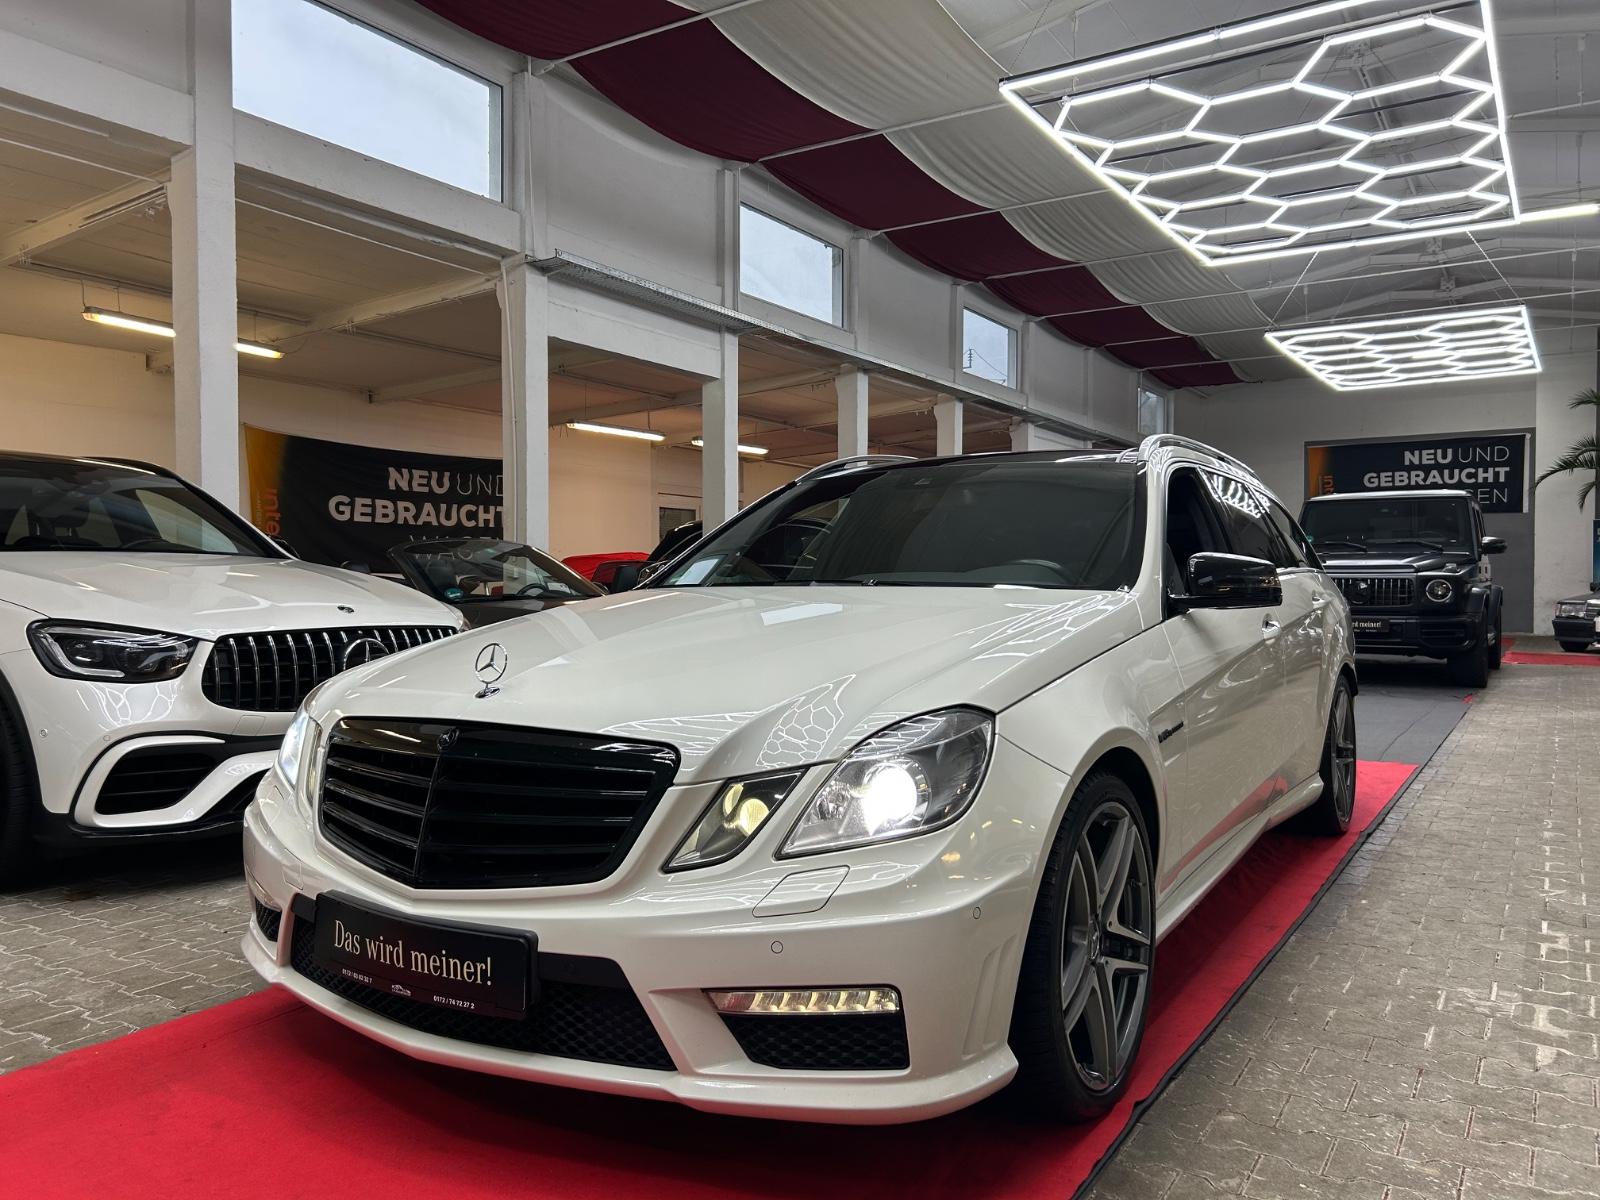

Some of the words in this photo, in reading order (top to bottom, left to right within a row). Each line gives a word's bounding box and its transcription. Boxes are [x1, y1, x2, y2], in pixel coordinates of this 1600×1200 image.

[1404, 448, 1453, 466] NEU
[1458, 445, 1510, 463] UND
[388, 467, 451, 495] NEU
[1363, 467, 1510, 488] GEBRAUCHT
[334, 919, 361, 955] Das
[366, 936, 404, 969] wird
[410, 950, 492, 986] meiner!
